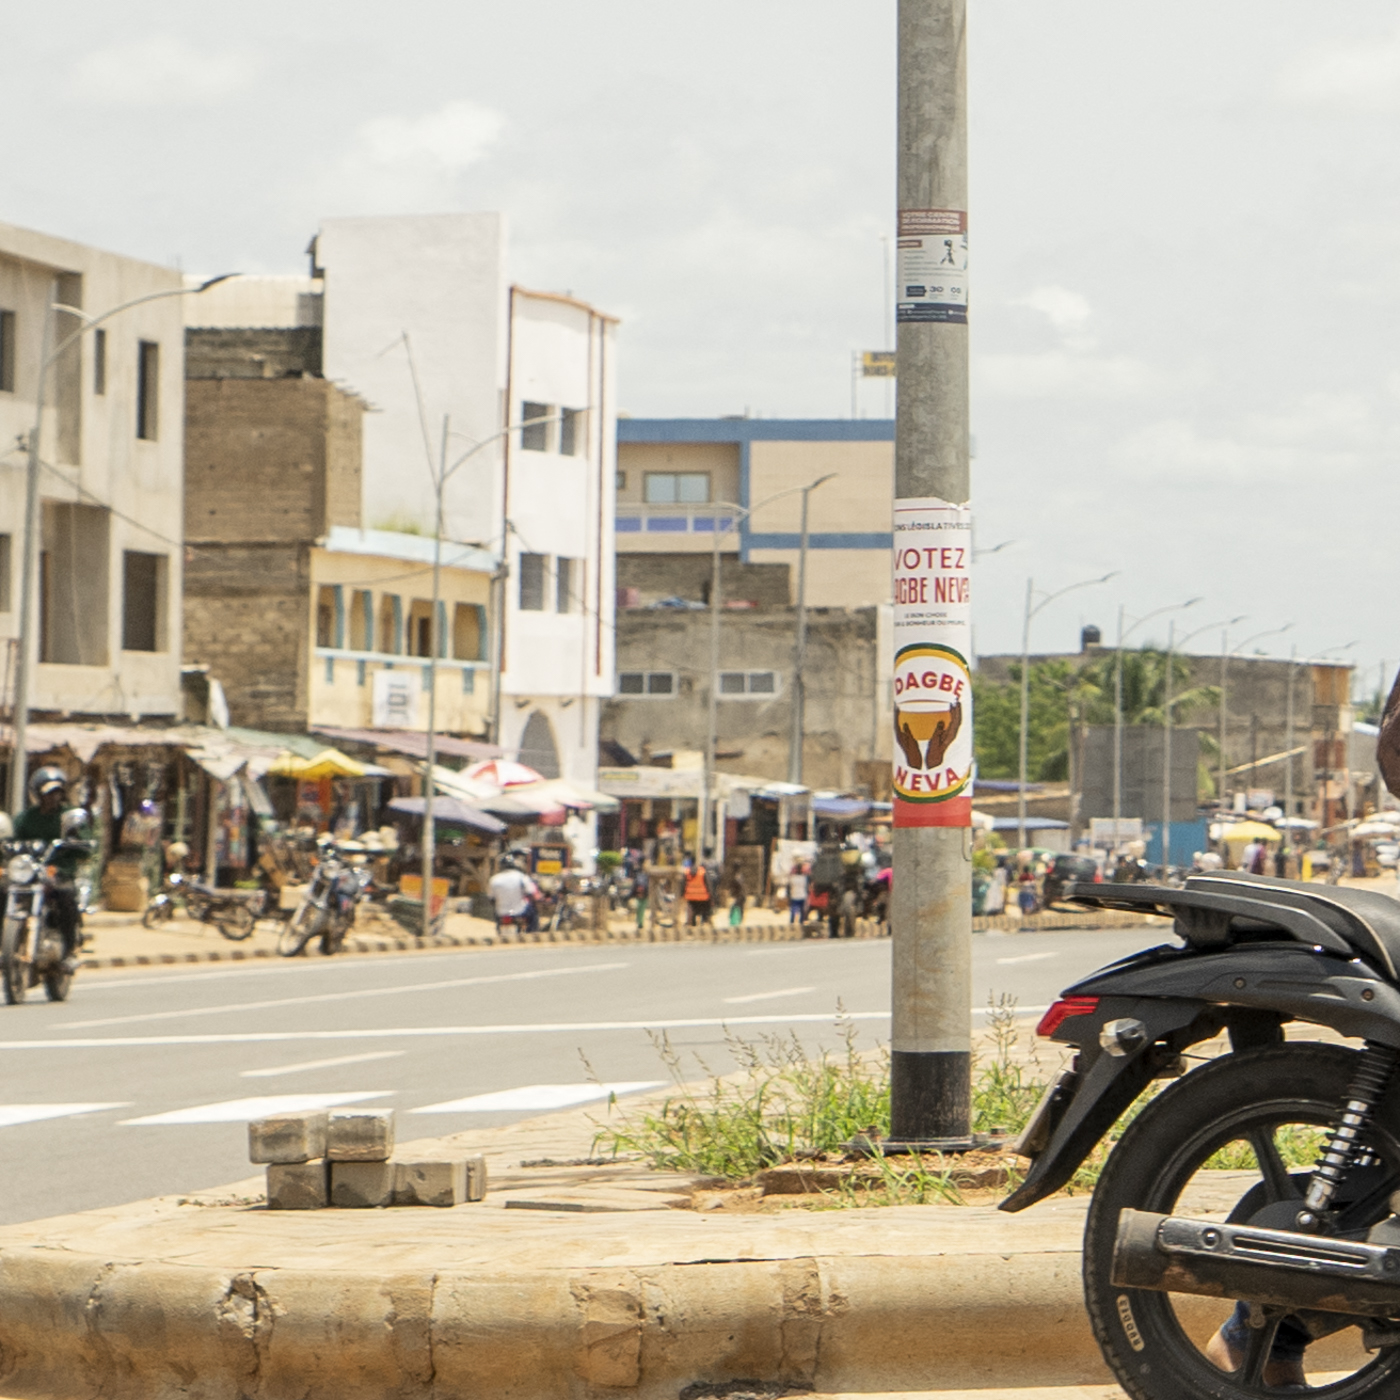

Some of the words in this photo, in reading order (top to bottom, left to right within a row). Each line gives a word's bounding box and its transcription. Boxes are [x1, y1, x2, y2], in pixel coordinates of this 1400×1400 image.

[894, 548, 964, 570] VOTEZ
[895, 671, 965, 698] DAGBE
[895, 766, 960, 791] NEVA
